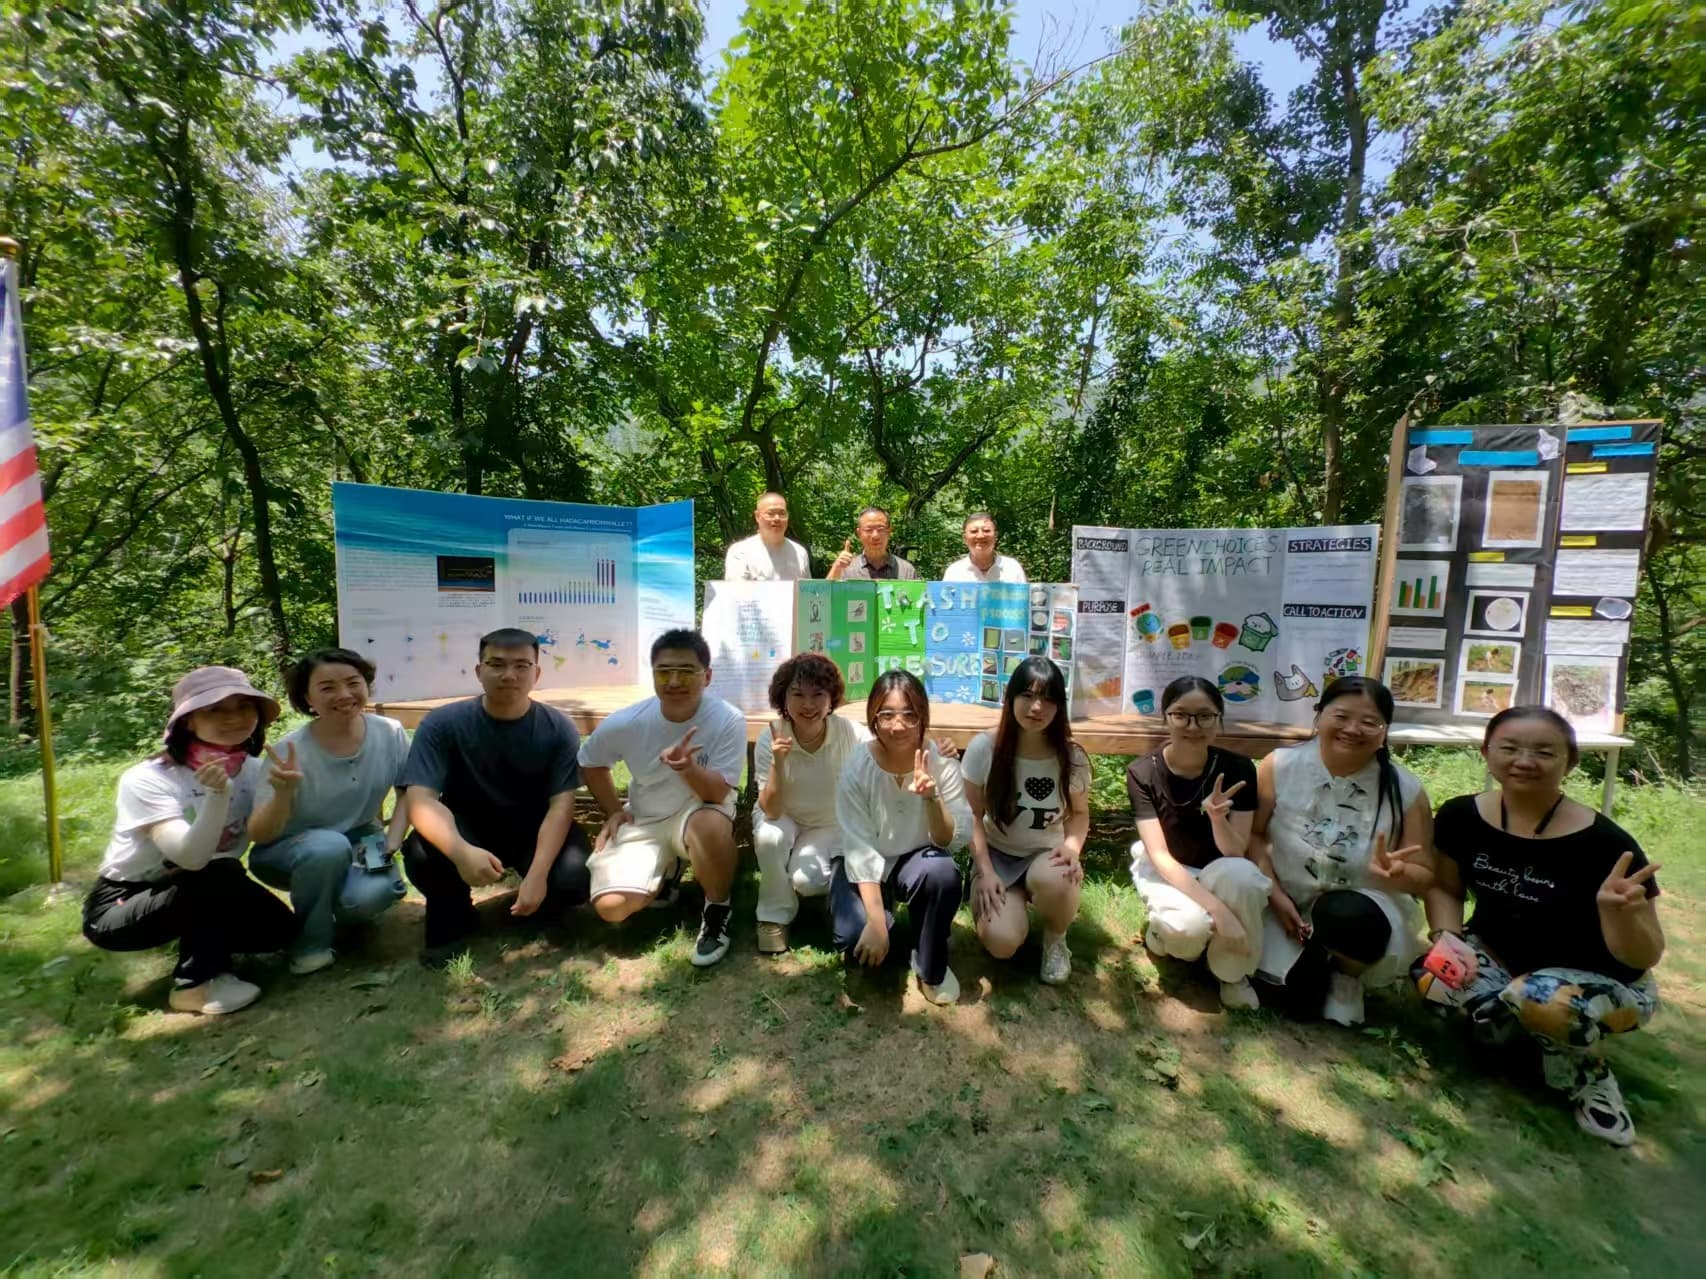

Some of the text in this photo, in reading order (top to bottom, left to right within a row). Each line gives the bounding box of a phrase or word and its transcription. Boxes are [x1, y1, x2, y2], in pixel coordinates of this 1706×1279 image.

[1078, 538, 1128, 551] BACKGROUND
[1290, 538, 1370, 552] STRATEGIES
[1141, 558, 1189, 576] REAL
[1199, 556, 1273, 576] IMPACT
[876, 583, 978, 610] TRASH
[1082, 601, 1119, 613] PURPOSE
[1283, 606, 1364, 619] CALL TO ACTION
[904, 618, 950, 646] TO
